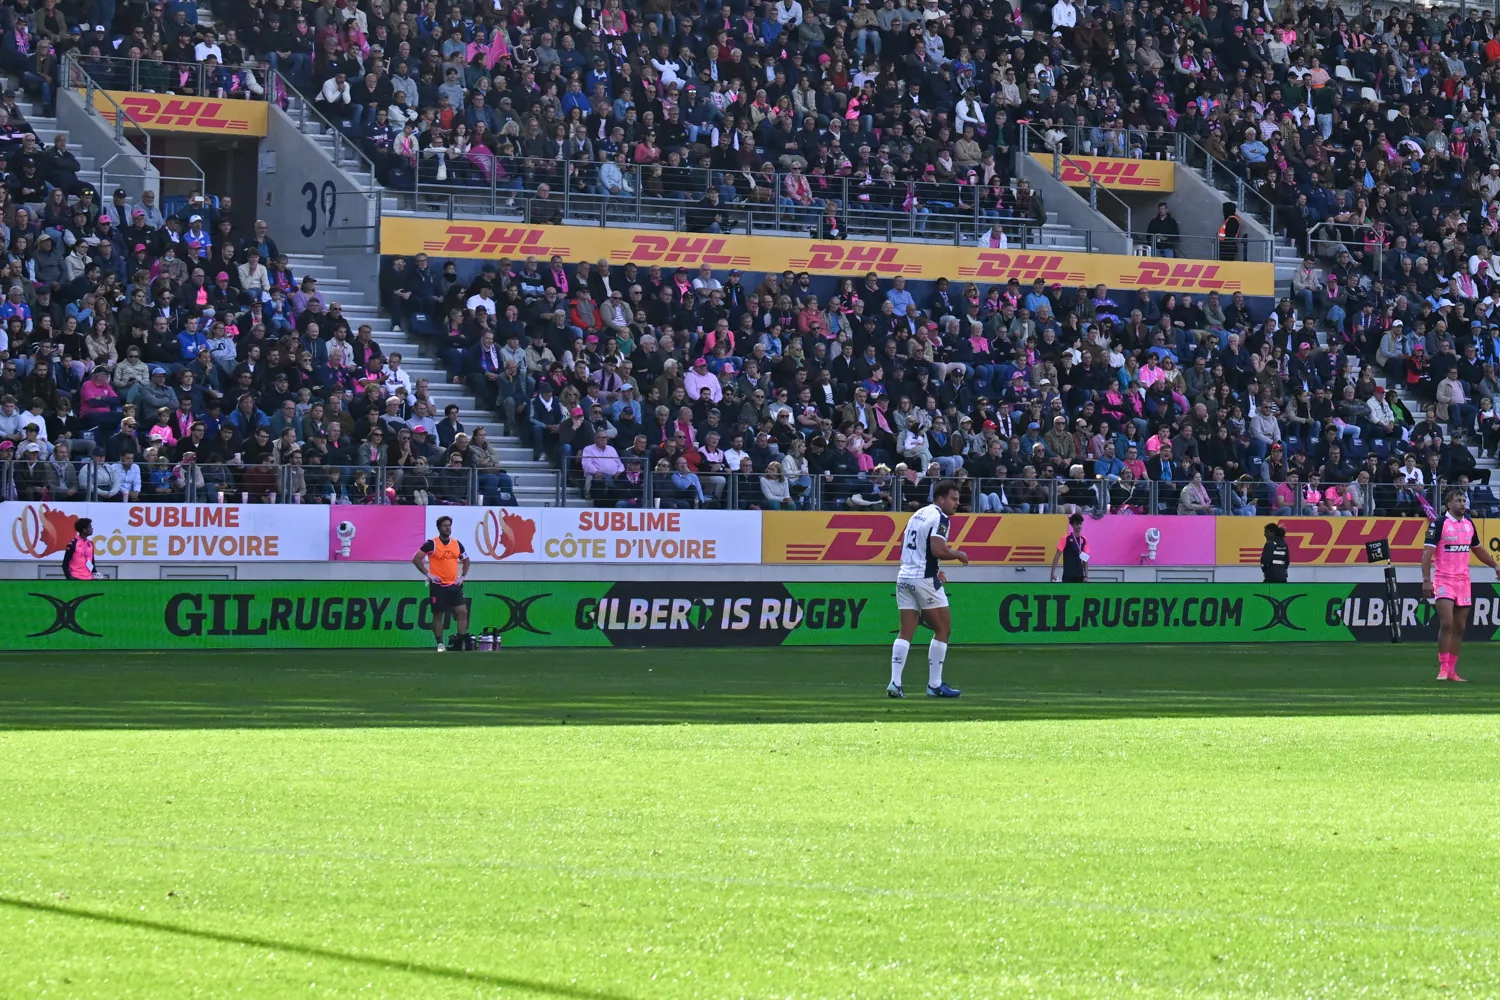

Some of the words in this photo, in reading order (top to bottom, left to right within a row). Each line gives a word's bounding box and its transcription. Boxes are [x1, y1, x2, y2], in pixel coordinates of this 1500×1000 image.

[121, 97, 229, 128] DHL
[1060, 160, 1145, 186] DHL
[300, 180, 337, 238] 39
[442, 226, 552, 255] DHL
[629, 235, 734, 264] DHL
[807, 244, 906, 272] DHL
[977, 252, 1069, 280] DHL
[1136, 261, 1225, 288] DHL
[128, 506, 240, 528] SUBLIME
[579, 511, 681, 532] SUBLIME
[94, 529, 158, 556] CÔTE
[545, 533, 606, 559] CÔTE
[1275, 519, 1432, 563] DHL
[1371, 552, 1383, 560] 14
[575, 598, 714, 630] GILBERT
[721, 598, 753, 630] IS
[759, 598, 868, 630] RUGBY
[999, 593, 1245, 633] GILRUGBY.COM
